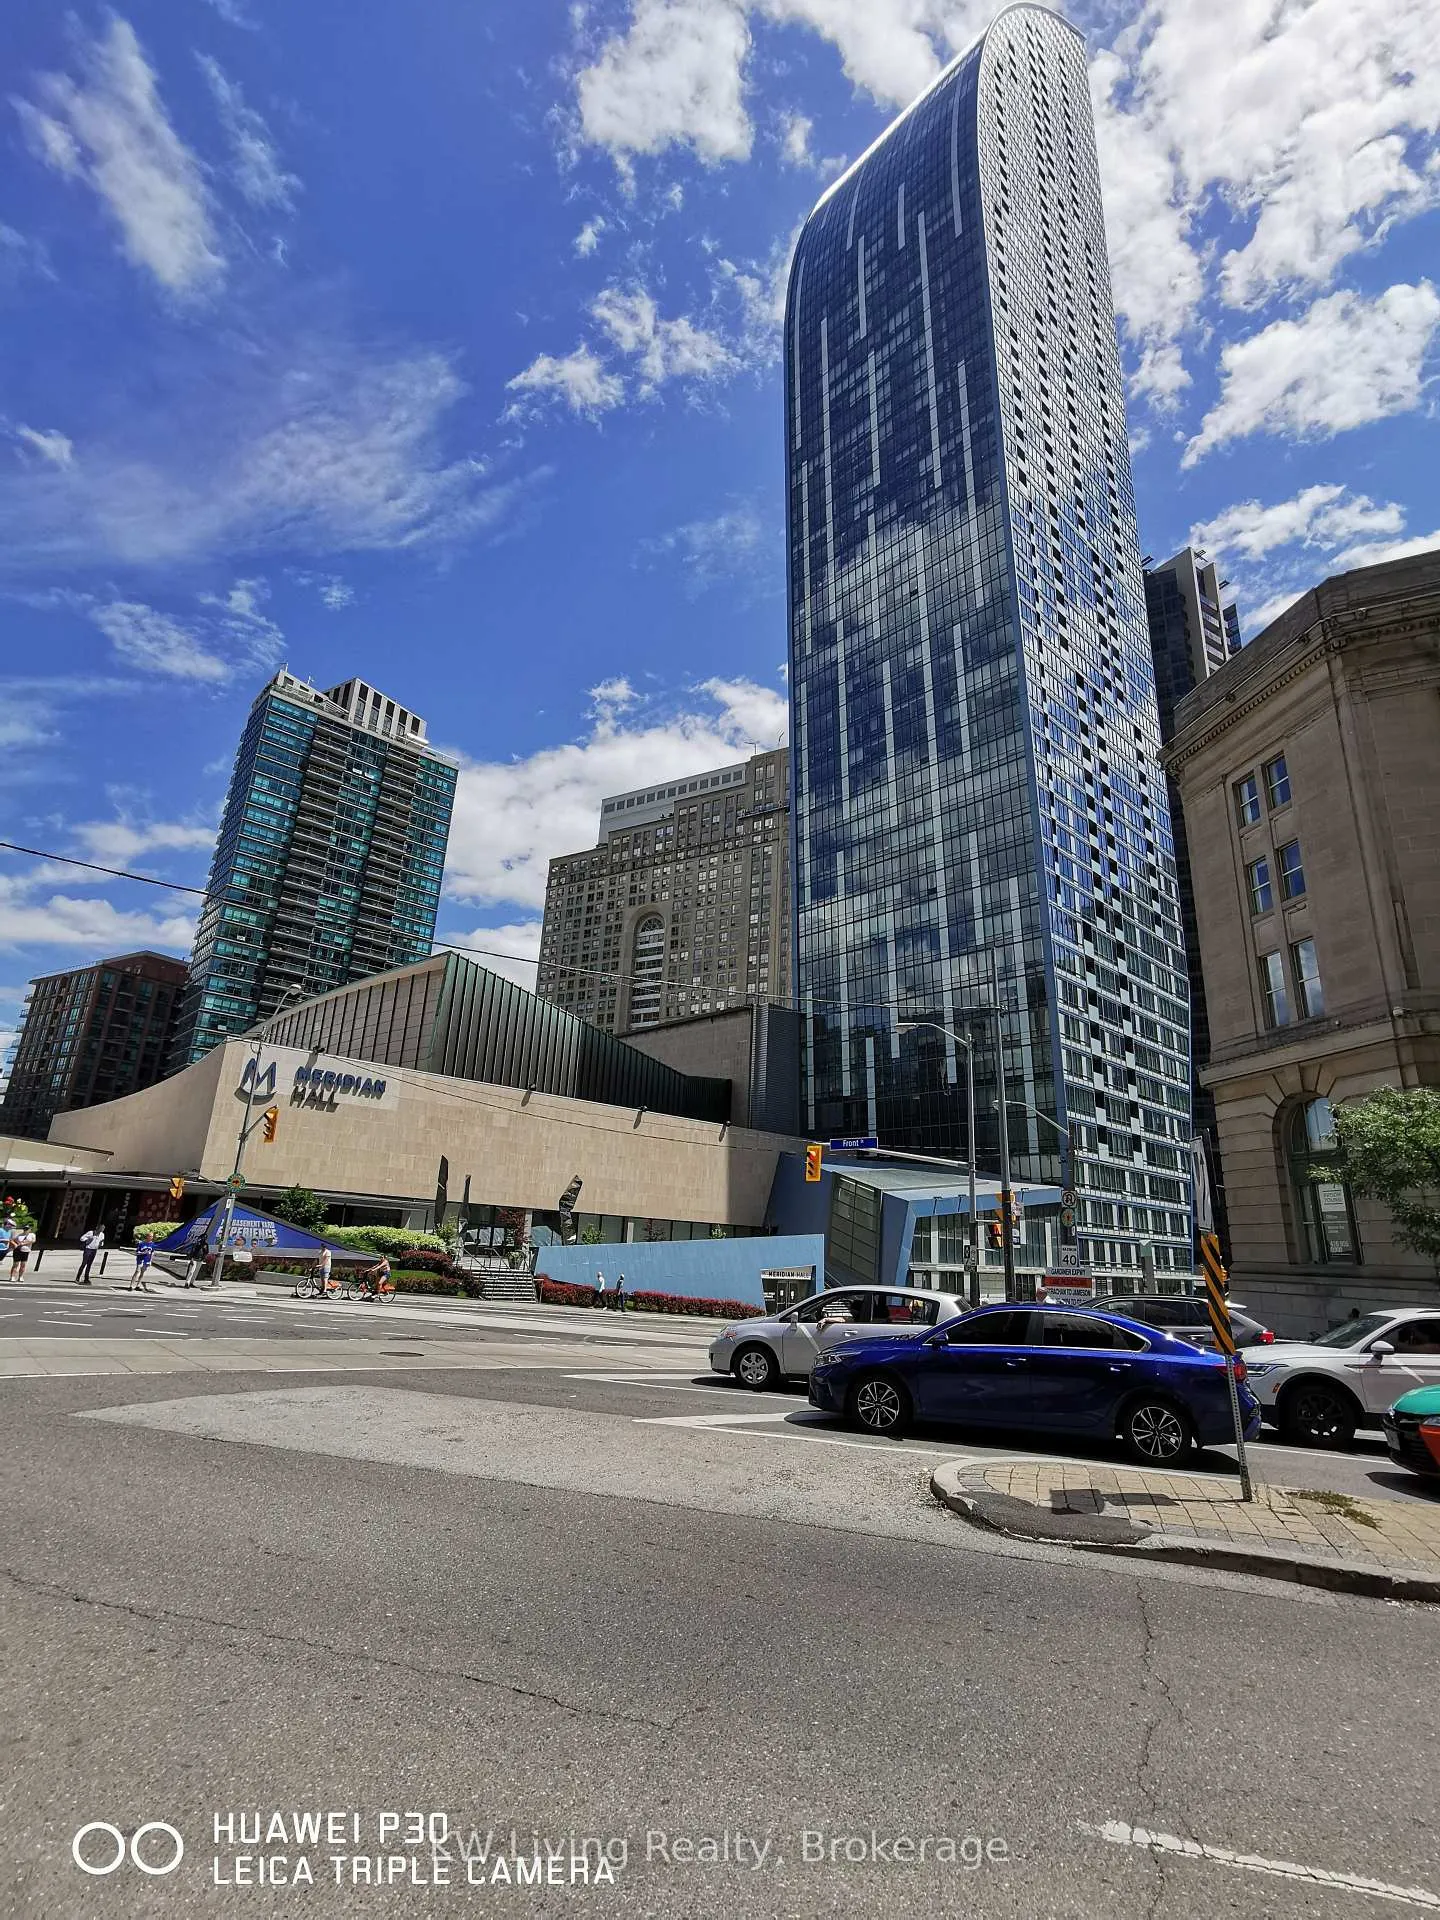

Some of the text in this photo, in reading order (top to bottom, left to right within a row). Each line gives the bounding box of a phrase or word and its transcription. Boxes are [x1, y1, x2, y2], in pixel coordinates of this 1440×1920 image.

[294, 1066, 386, 1097] MERIDIAN
[290, 1086, 338, 1111] HALL
[842, 1139, 859, 1147] Front
[215, 1226, 279, 1241] EPERIENCE
[1062, 1254, 1077, 1266] 40
